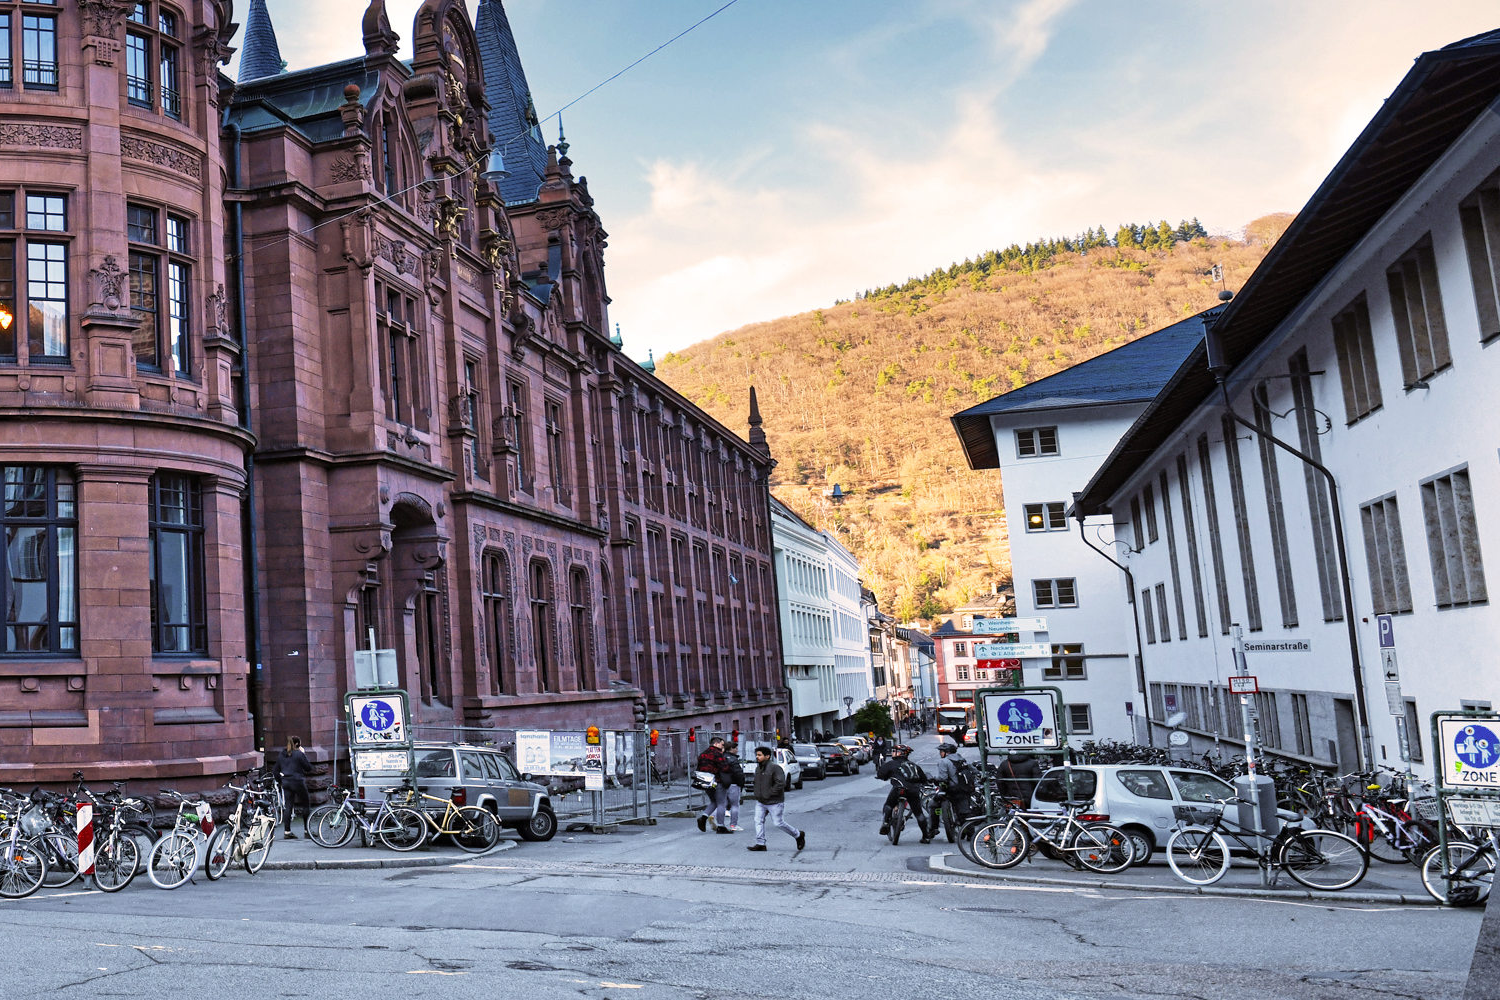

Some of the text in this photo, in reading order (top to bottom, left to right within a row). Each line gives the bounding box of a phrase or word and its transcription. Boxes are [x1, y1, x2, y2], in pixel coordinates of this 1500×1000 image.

[1381, 619, 1390, 645] P
[1244, 641, 1308, 651] Seminarstraße
[553, 735, 582, 743] FILMTAGE
[1005, 735, 1041, 745] ZONE
[1462, 770, 1498, 783] ZONE
